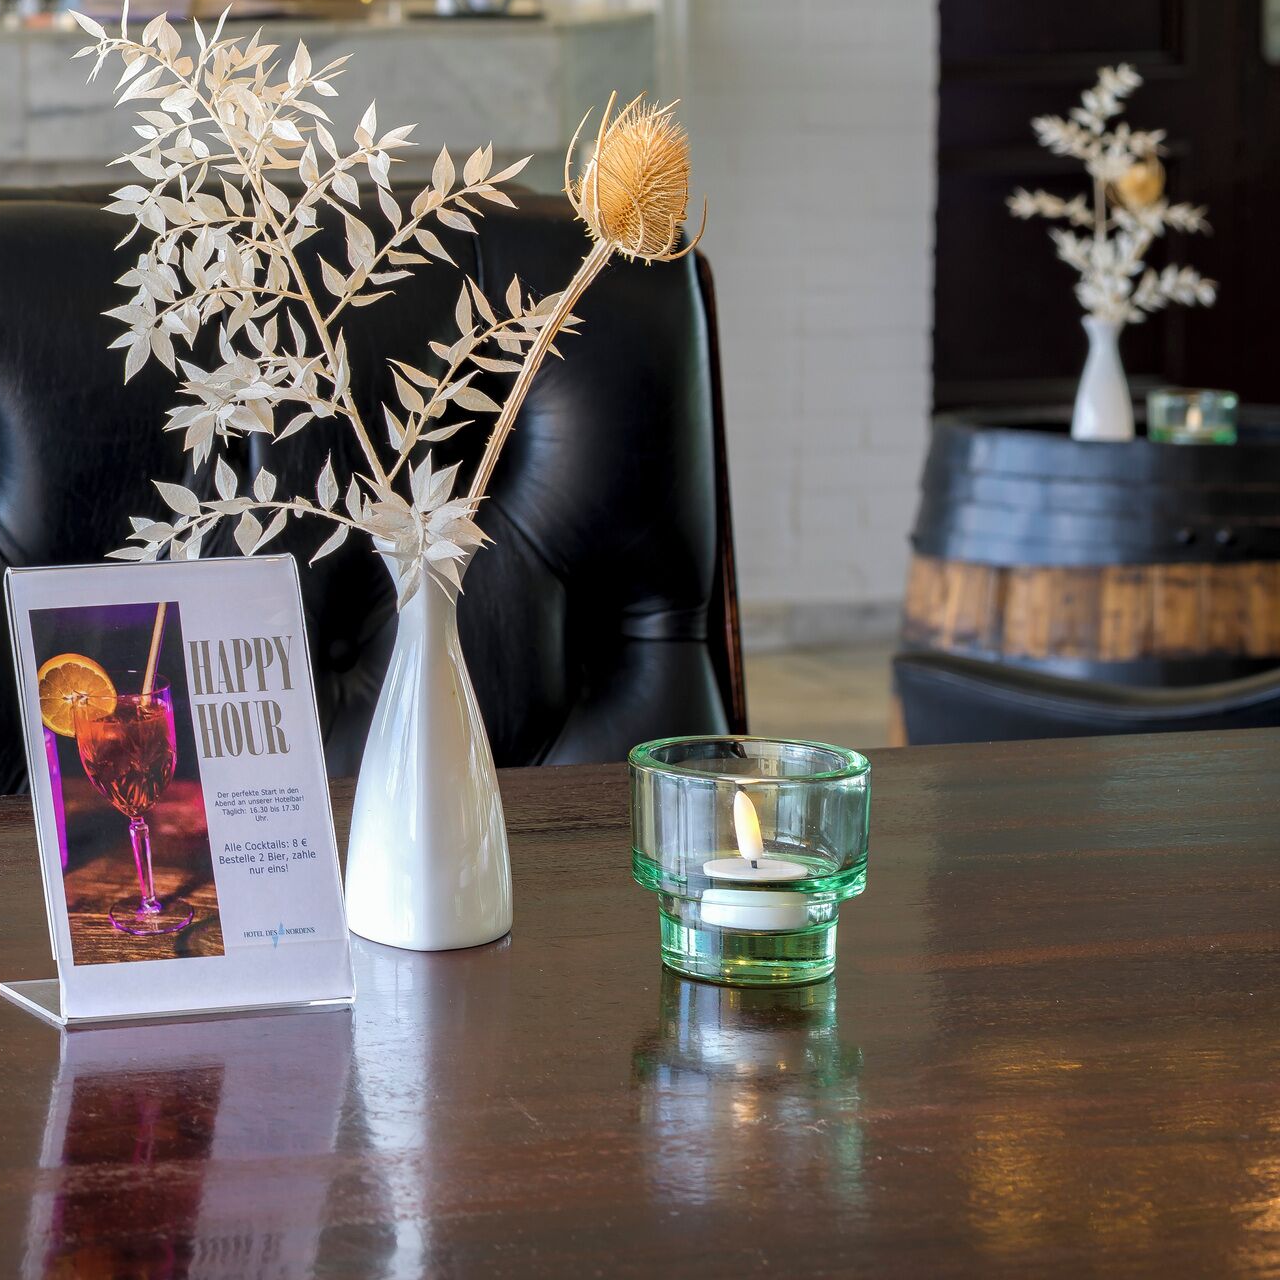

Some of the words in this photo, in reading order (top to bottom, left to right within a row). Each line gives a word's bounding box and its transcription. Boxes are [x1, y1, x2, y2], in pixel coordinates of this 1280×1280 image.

[188, 635, 294, 695] HAPPY
[195, 700, 291, 758] HOUR
[231, 790, 260, 799] perfekte
[261, 788, 278, 796] Start
[248, 797, 272, 805] unserer
[281, 804, 300, 812] 17.30
[224, 843, 242, 852] Alle
[245, 840, 290, 851] Cocktails:
[292, 839, 299, 847] 8
[301, 838, 307, 847] €
[219, 854, 256, 865] Bestelle
[258, 853, 265, 862] 2
[267, 852, 289, 862] Bier,
[292, 850, 317, 860] zahle
[249, 867, 264, 875] nur
[267, 864, 289, 873] eins!
[243, 930, 264, 938] HOTEL
[265, 929, 278, 937] DES
[285, 927, 316, 935] NORDENS
